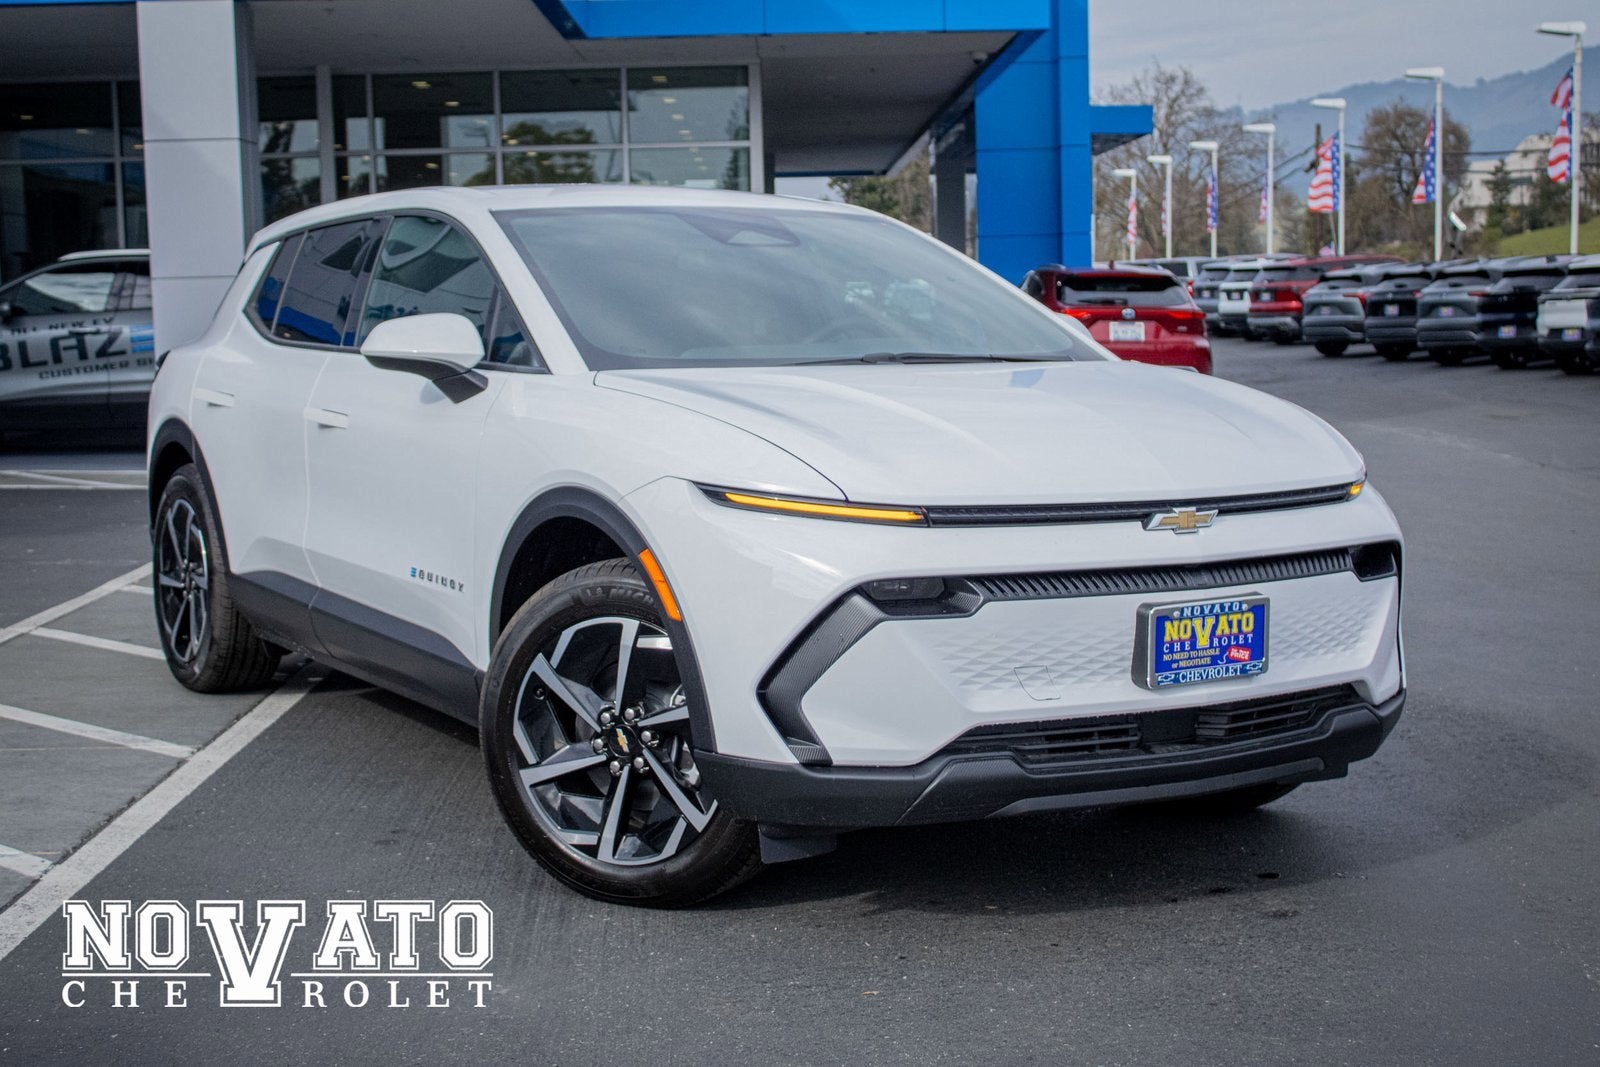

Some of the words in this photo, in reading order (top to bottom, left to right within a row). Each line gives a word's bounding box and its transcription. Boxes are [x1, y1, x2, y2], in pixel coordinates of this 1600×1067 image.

[39, 359, 130, 380] CUSTOMER
[1183, 601, 1240, 617] NOVATO
[1164, 611, 1254, 649] NOVATO
[1163, 654, 1173, 662] NO
[1172, 652, 1190, 660] NEED
[1189, 650, 1199, 659] TO
[1198, 648, 1221, 657] HASSLE
[1178, 657, 1212, 668] NEGOTIATE
[1179, 664, 1242, 683] CHEVROLET
